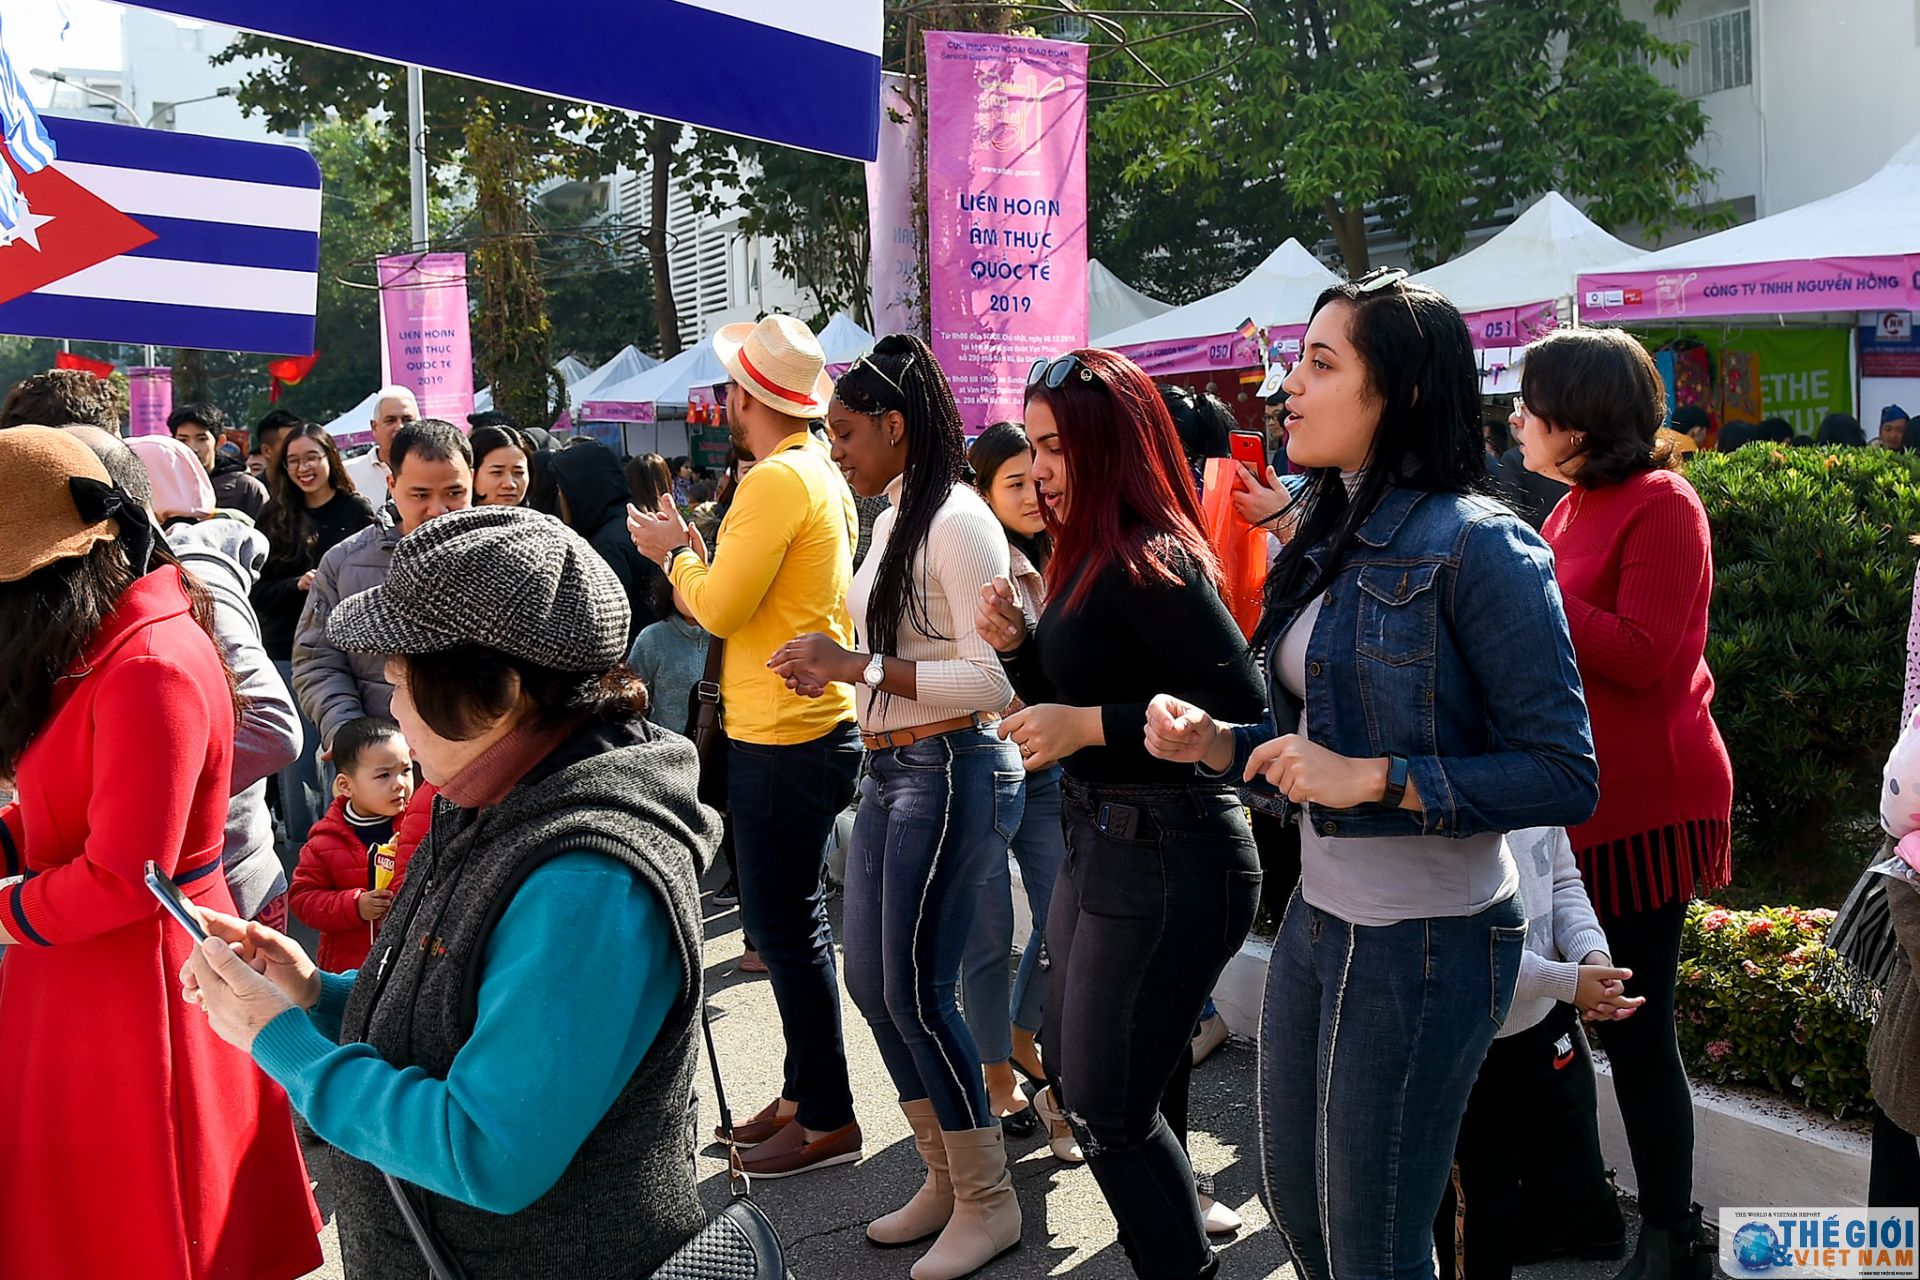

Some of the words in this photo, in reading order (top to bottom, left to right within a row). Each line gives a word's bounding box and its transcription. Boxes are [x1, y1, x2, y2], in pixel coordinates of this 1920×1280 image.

[960, 189, 998, 213] LIÊN
[1004, 198, 1060, 216] HOAN
[1003, 230, 1052, 254] THỰC
[971, 253, 1023, 280] QUỐC
[1741, 283, 1757, 296] TY
[1760, 281, 1793, 295] TNHH
[990, 294, 1031, 313] 2019
[425, 329, 455, 338] HOAN
[1485, 321, 1511, 338] 051
[1209, 344, 1229, 359] 050
[418, 376, 443, 386] 2019
